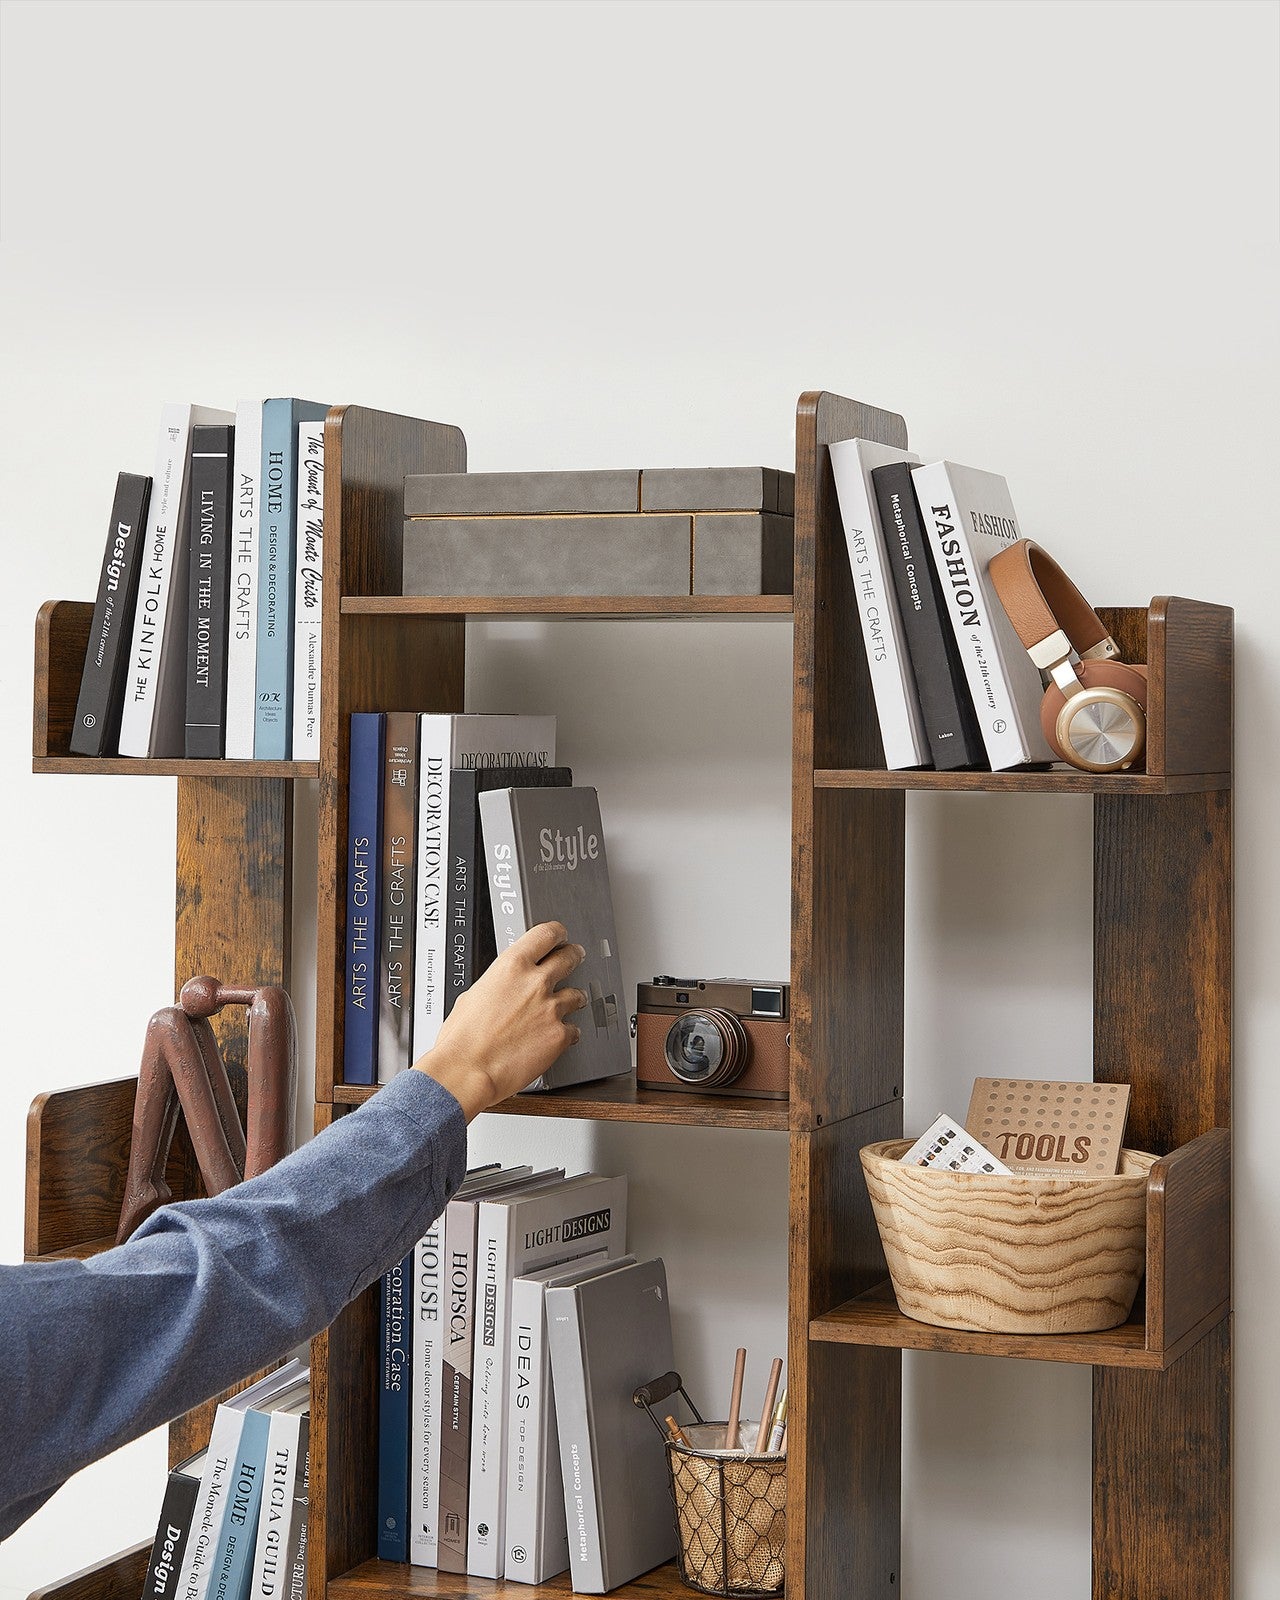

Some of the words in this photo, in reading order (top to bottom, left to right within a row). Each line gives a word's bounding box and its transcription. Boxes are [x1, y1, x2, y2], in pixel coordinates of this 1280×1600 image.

[307, 432, 324, 454] The
[240, 474, 254, 518] ARTS
[268, 451, 284, 514] HOME
[304, 460, 324, 495] Count
[200, 490, 215, 545] LIVING
[300, 498, 323, 510] of
[153, 525, 166, 561] HOME
[269, 526, 277, 561] DESIGN
[305, 518, 323, 562] Monte
[970, 510, 1018, 540] FASHION
[107, 522, 131, 591] Design
[200, 553, 212, 569] IN
[238, 527, 252, 562] THE
[852, 528, 869, 564] ARTS
[890, 493, 912, 560] Metaphorical
[906, 564, 922, 612] Concepts
[268, 564, 276, 572] &
[931, 504, 981, 627] FASHION
[106, 596, 114, 607] of
[198, 576, 212, 609] THE
[300, 568, 322, 608] Cristo
[859, 570, 876, 600] THE
[104, 608, 112, 619] the
[138, 566, 162, 670] KINFOLK
[236, 572, 250, 640] CRAFTS
[268, 574, 276, 637] DECORATING
[95, 638, 106, 668] century
[196, 617, 210, 687] MOMENT
[866, 606, 887, 662] CRAFTS
[970, 634, 982, 644] of
[974, 646, 984, 658] the
[308, 632, 316, 680] Alexandre
[134, 677, 147, 702] THE
[308, 682, 316, 714] Dumas
[984, 679, 996, 710] century
[306, 718, 315, 738] Pere
[461, 752, 526, 768] DECORATION
[527, 751, 548, 768] CASE
[426, 757, 443, 880] DECORATION
[540, 826, 598, 870] Style
[354, 837, 369, 906] CRAFTS
[390, 836, 406, 906] CRAFTS
[455, 856, 466, 892] ARTS
[494, 844, 517, 915] Style
[424, 884, 440, 929] CASE
[454, 898, 466, 927] THE
[353, 916, 368, 954] THE
[389, 914, 404, 952] THE
[505, 926, 514, 937] of
[427, 949, 436, 982] Interior
[454, 934, 466, 986] CRAFTS
[352, 962, 366, 1010] ARTS
[388, 962, 402, 1008] ARTS
[426, 985, 434, 1015] Design
[996, 1132, 1092, 1164] TOOLS
[525, 1226, 562, 1250] LIGHT
[564, 1212, 610, 1239] DESIGNS
[420, 1220, 438, 1322] HOUSE
[487, 1238, 497, 1282] LIGHT
[392, 1260, 406, 1344] coration
[450, 1251, 468, 1345] HOPSCA
[484, 1285, 496, 1346] DESIGNS
[391, 1348, 406, 1392] Case
[424, 1340, 433, 1368] Home
[516, 1325, 532, 1410] IDEAS
[424, 1370, 432, 1398] decor
[422, 1400, 432, 1428] styles
[424, 1430, 432, 1444] for
[213, 1458, 228, 1480] The
[422, 1446, 430, 1474] every
[571, 1444, 582, 1490] Concepts
[231, 1462, 256, 1526] HOME
[270, 1448, 289, 1522] TRICIA
[201, 1482, 222, 1532] Monocle
[297, 1523, 307, 1560] Designer
[574, 1495, 588, 1562] Metaphorical
[154, 1524, 181, 1594] Design
[192, 1534, 210, 1570] Guide
[222, 1536, 236, 1572] DESIGN
[261, 1530, 280, 1596] GUILD
[190, 1572, 198, 1584] to
[220, 1572, 228, 1582] &
